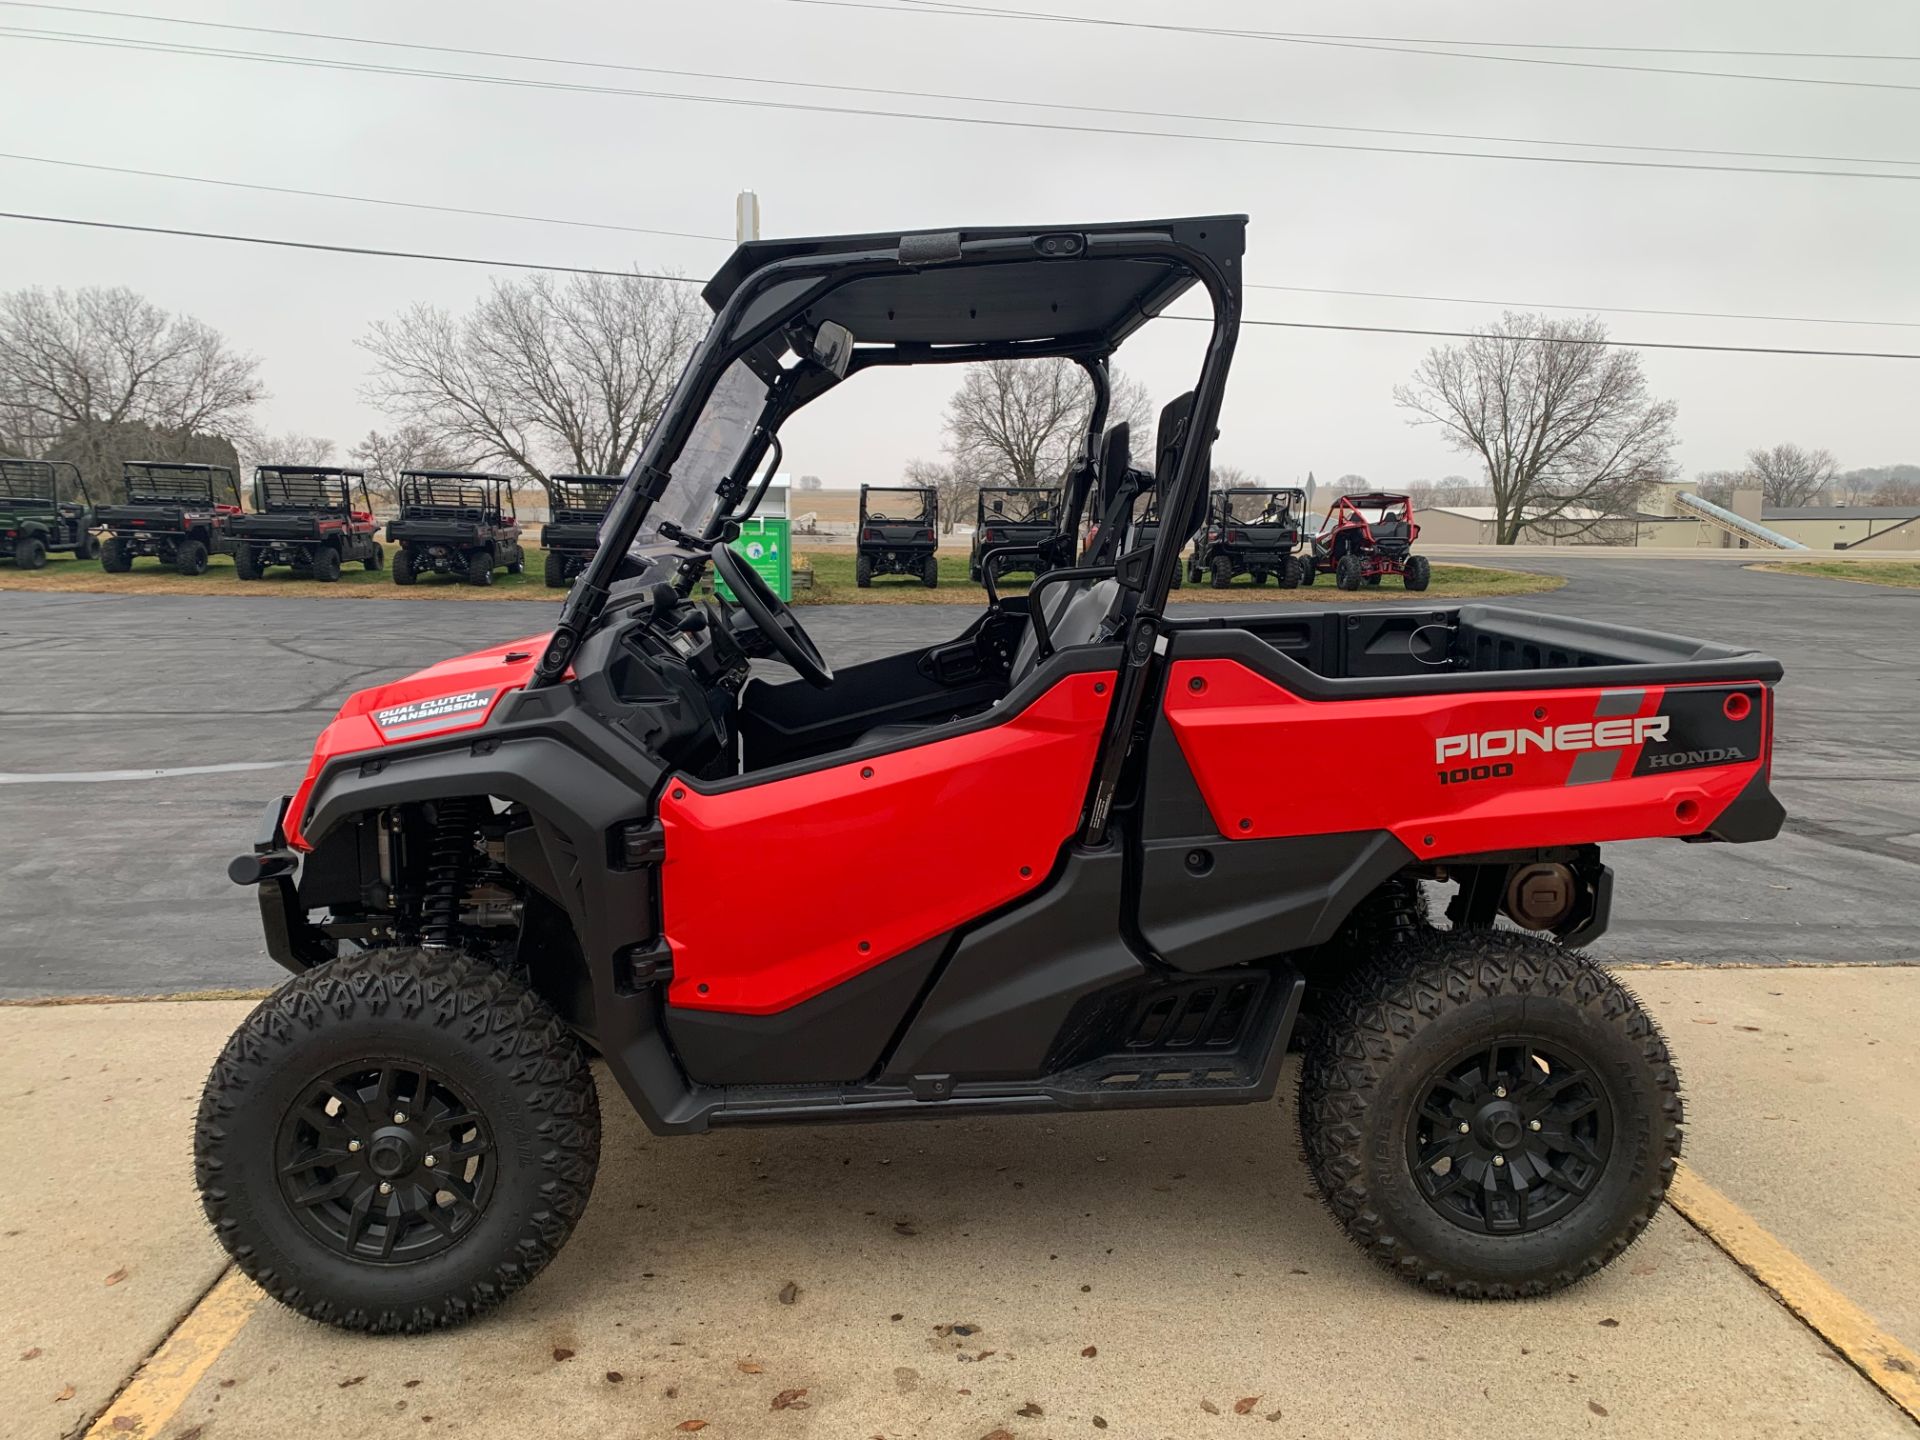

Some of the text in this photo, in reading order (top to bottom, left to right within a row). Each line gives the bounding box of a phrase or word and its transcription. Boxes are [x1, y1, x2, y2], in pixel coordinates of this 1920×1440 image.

[379, 692, 477, 718] DUAL CLUTCH
[380, 697, 490, 726] TRANSMISSION
[1435, 715, 1670, 764] PIONEER
[1648, 746, 1746, 768] HONDA
[1437, 762, 1514, 785] 1000
[1628, 1113, 1650, 1183] TRAIL
